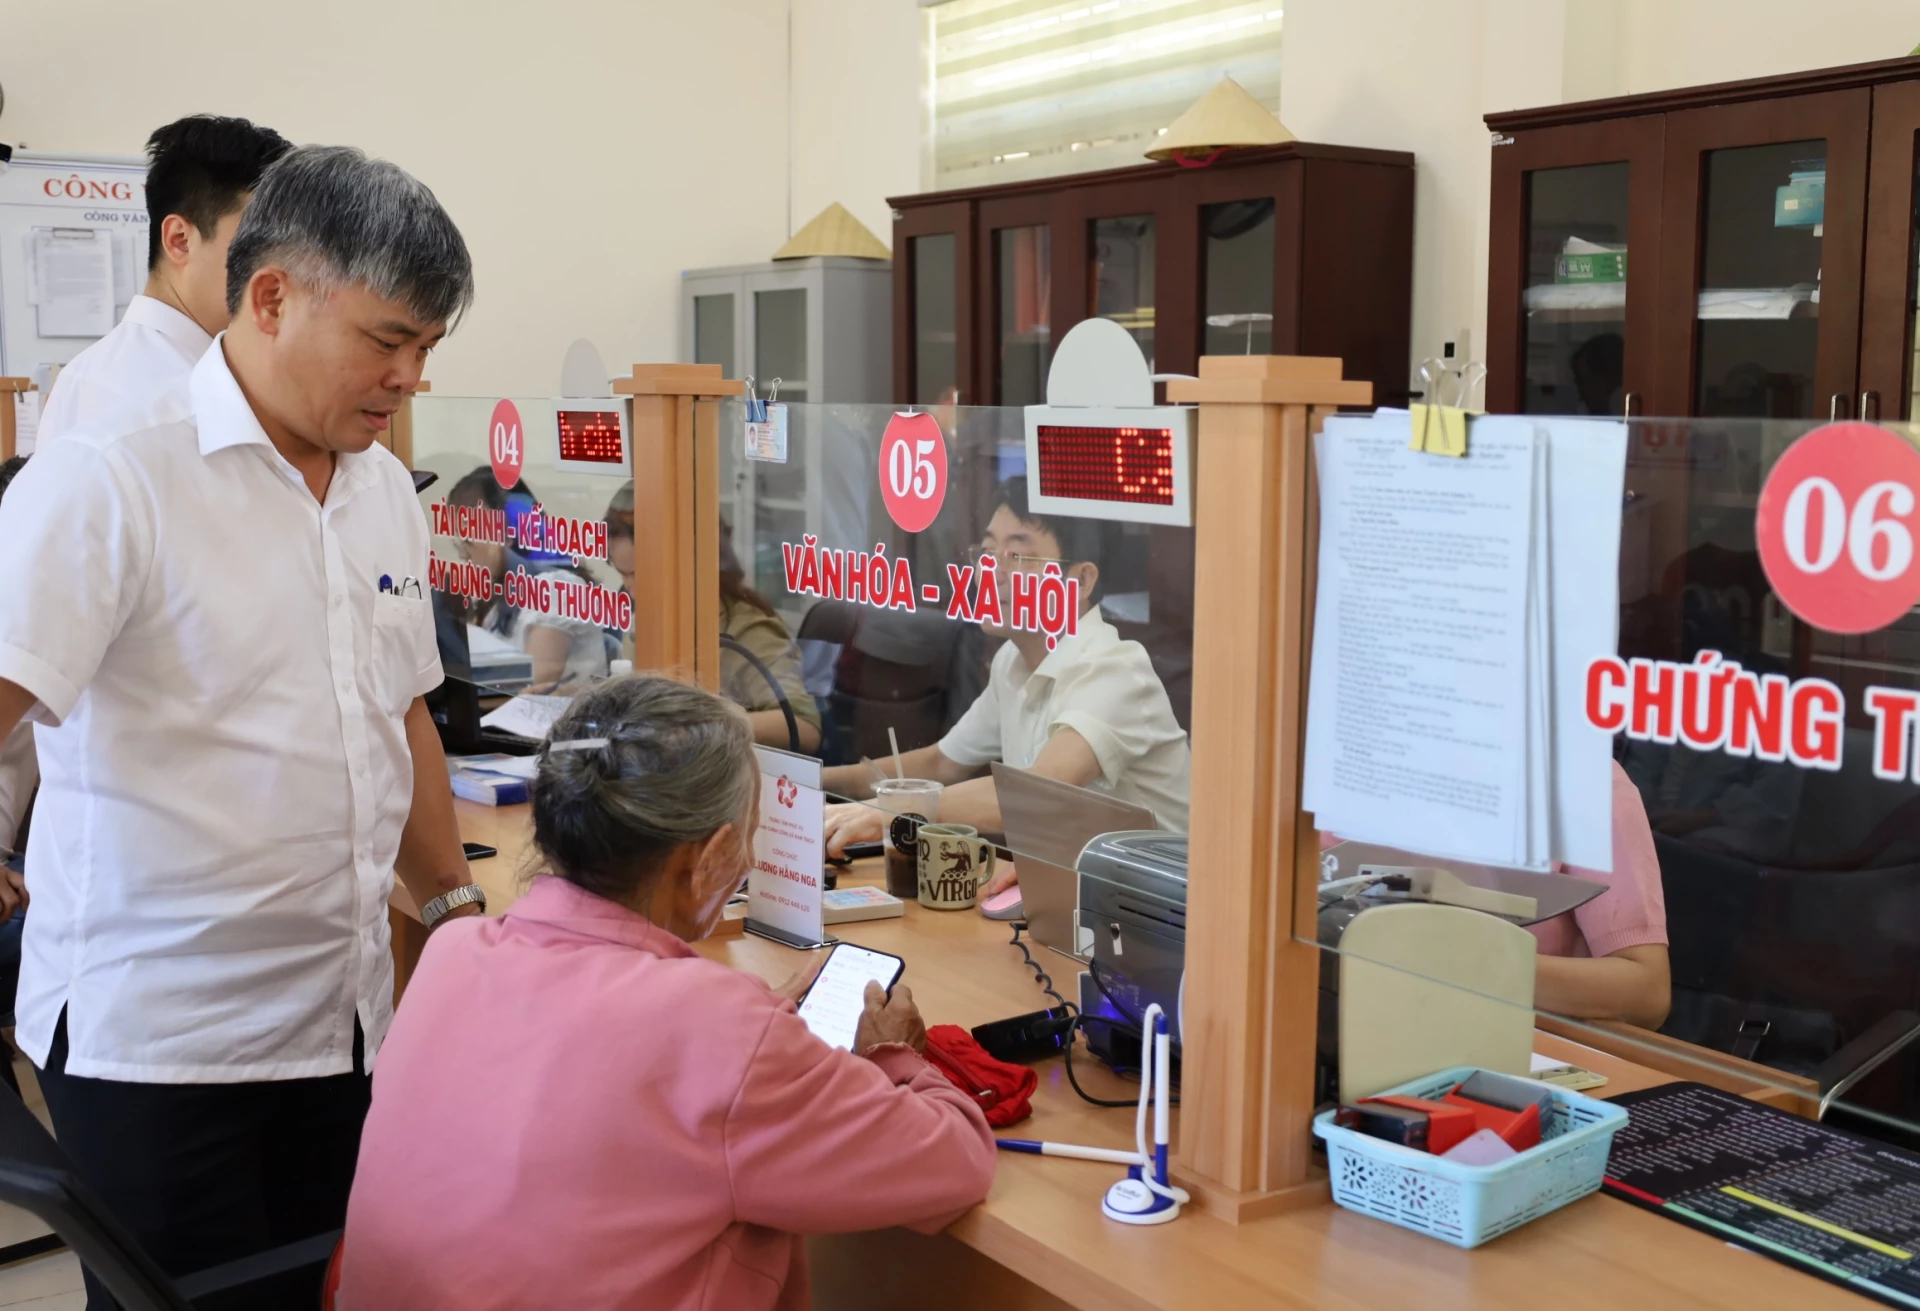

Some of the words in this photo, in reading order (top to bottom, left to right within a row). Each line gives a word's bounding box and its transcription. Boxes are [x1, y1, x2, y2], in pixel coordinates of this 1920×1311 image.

[43, 174, 133, 200] CÔNG
[84, 210, 118, 222] CÔNG
[494, 422, 518, 466] 04
[889, 439, 937, 500] 05
[431, 497, 455, 537] TÀI
[457, 500, 505, 546] CHÍNH
[507, 526, 516, 538] -
[518, 503, 542, 549] KẾ
[545, 514, 608, 567] HOẠCH
[1783, 476, 1915, 582] 06
[429, 550, 447, 592] ÂY
[450, 560, 491, 608] DỰNG
[494, 582, 503, 595] -
[505, 564, 550, 614] CÔNG
[554, 581, 631, 631] THƯƠNG
[782, 533, 843, 600] VĂN
[846, 543, 916, 612] HÓA
[922, 584, 940, 602] -
[946, 554, 1003, 627] XÃ
[1011, 562, 1079, 651] HỘI
[1585, 651, 1845, 771] CHỨNG
[1865, 686, 1920, 786] T
[772, 847, 785, 857] CÔNG
[801, 873, 817, 888] NGA
[927, 878, 978, 902] VIRGO
